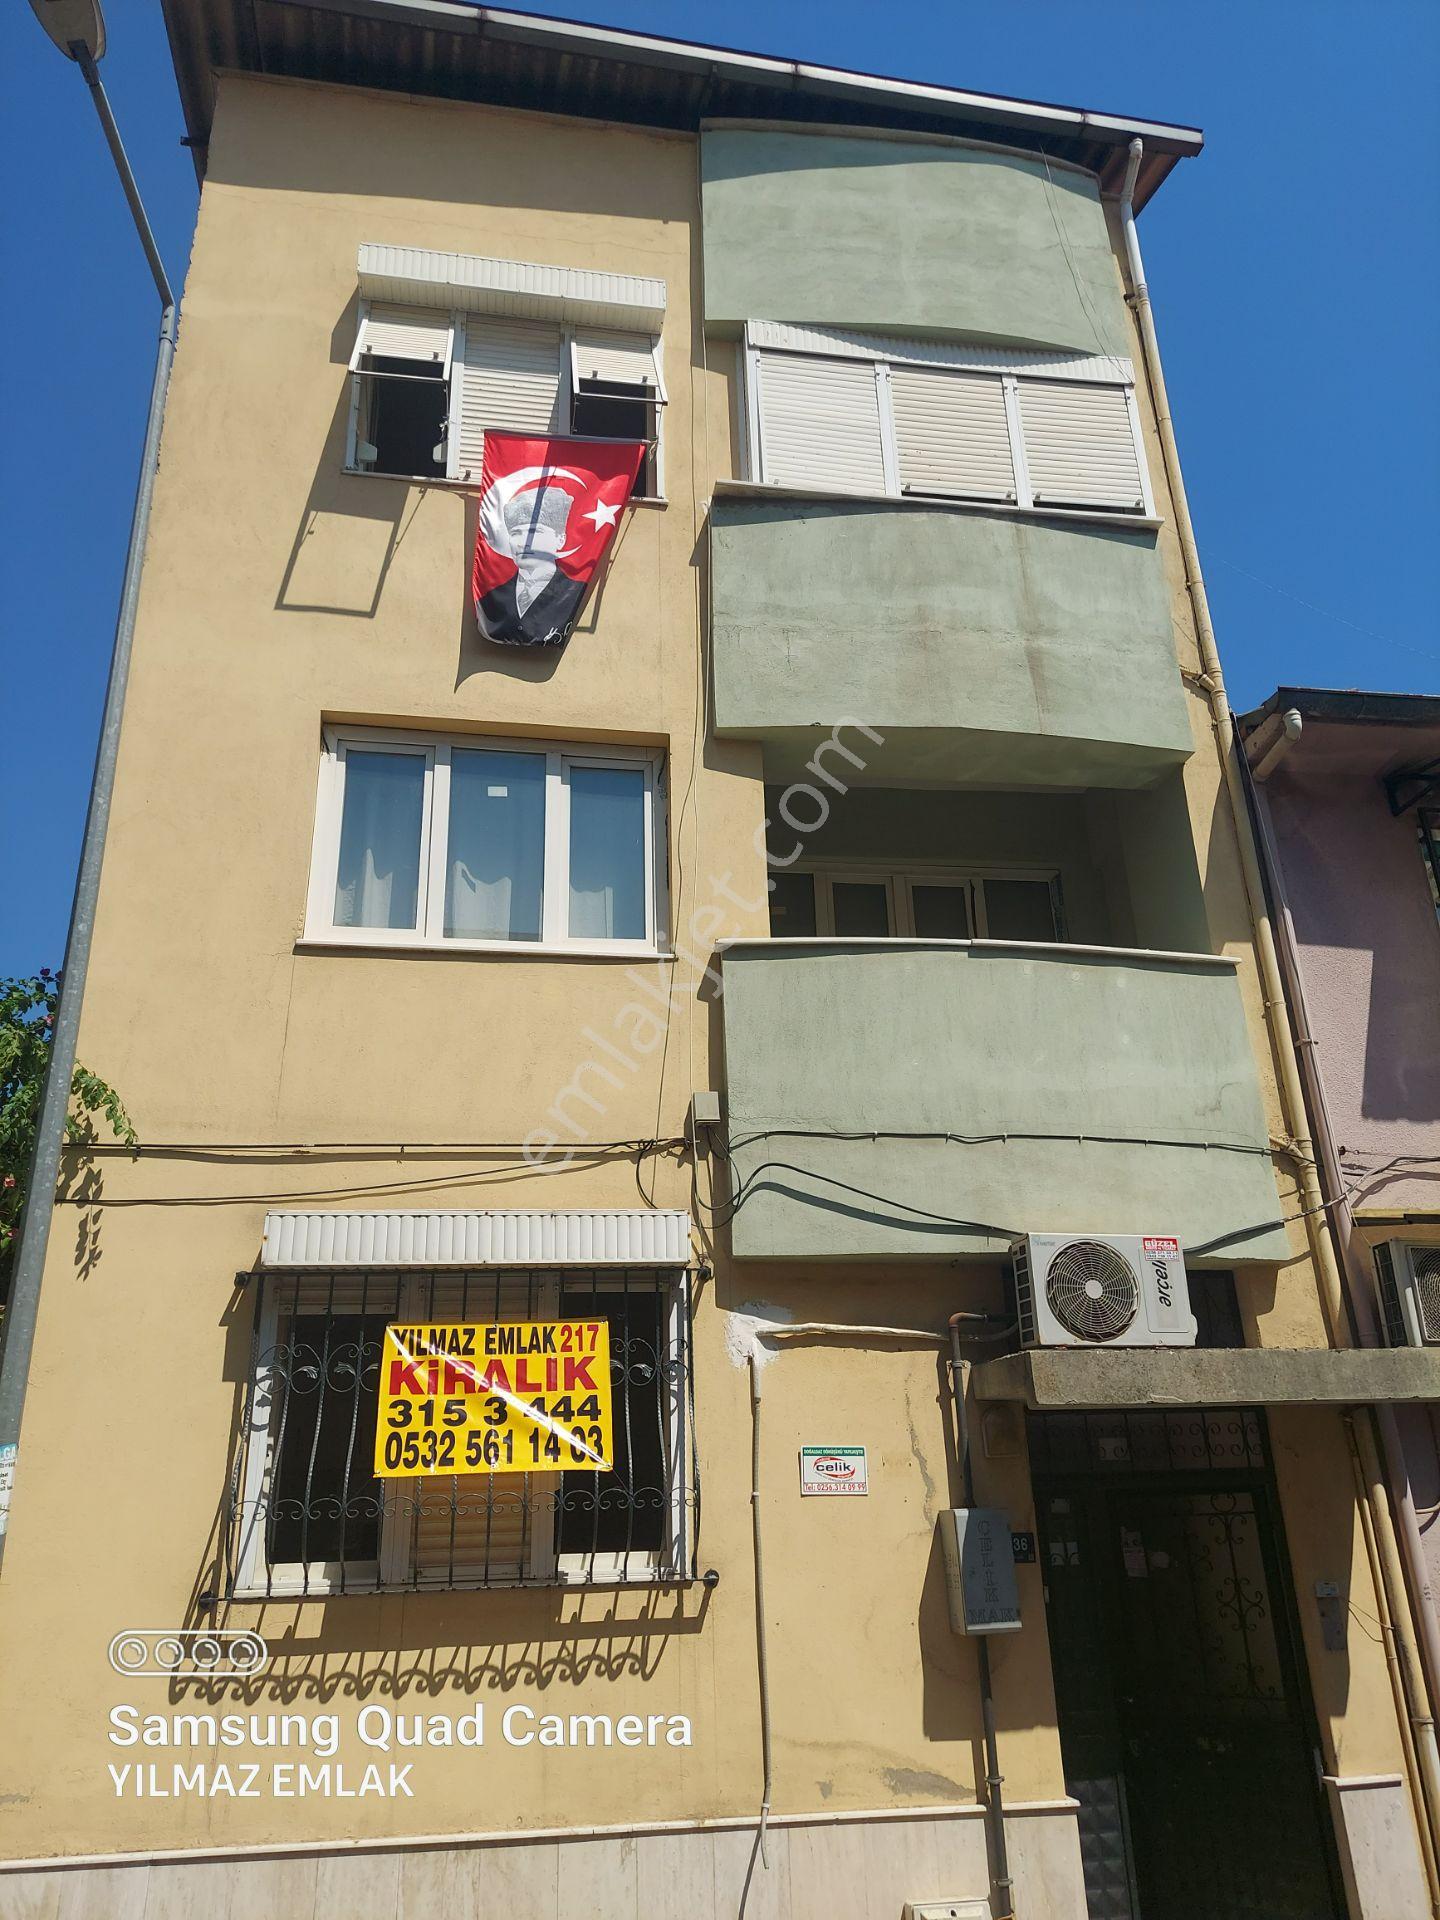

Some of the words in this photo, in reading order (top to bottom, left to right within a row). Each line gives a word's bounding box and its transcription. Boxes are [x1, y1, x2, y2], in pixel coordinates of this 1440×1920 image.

[1151, 1260, 1173, 1307] arçeli
[394, 1327, 476, 1355] YILMAZ
[484, 1325, 556, 1355] EMLAK
[560, 1324, 599, 1352] 217
[387, 1398, 468, 1428] 315
[483, 1396, 508, 1426] 3
[523, 1394, 602, 1423] 444
[384, 1429, 456, 1470] 0532
[465, 1428, 514, 1467] 561
[529, 1427, 561, 1463] 14
[570, 1425, 604, 1464] 03
[1013, 1537, 1028, 1551] 36
